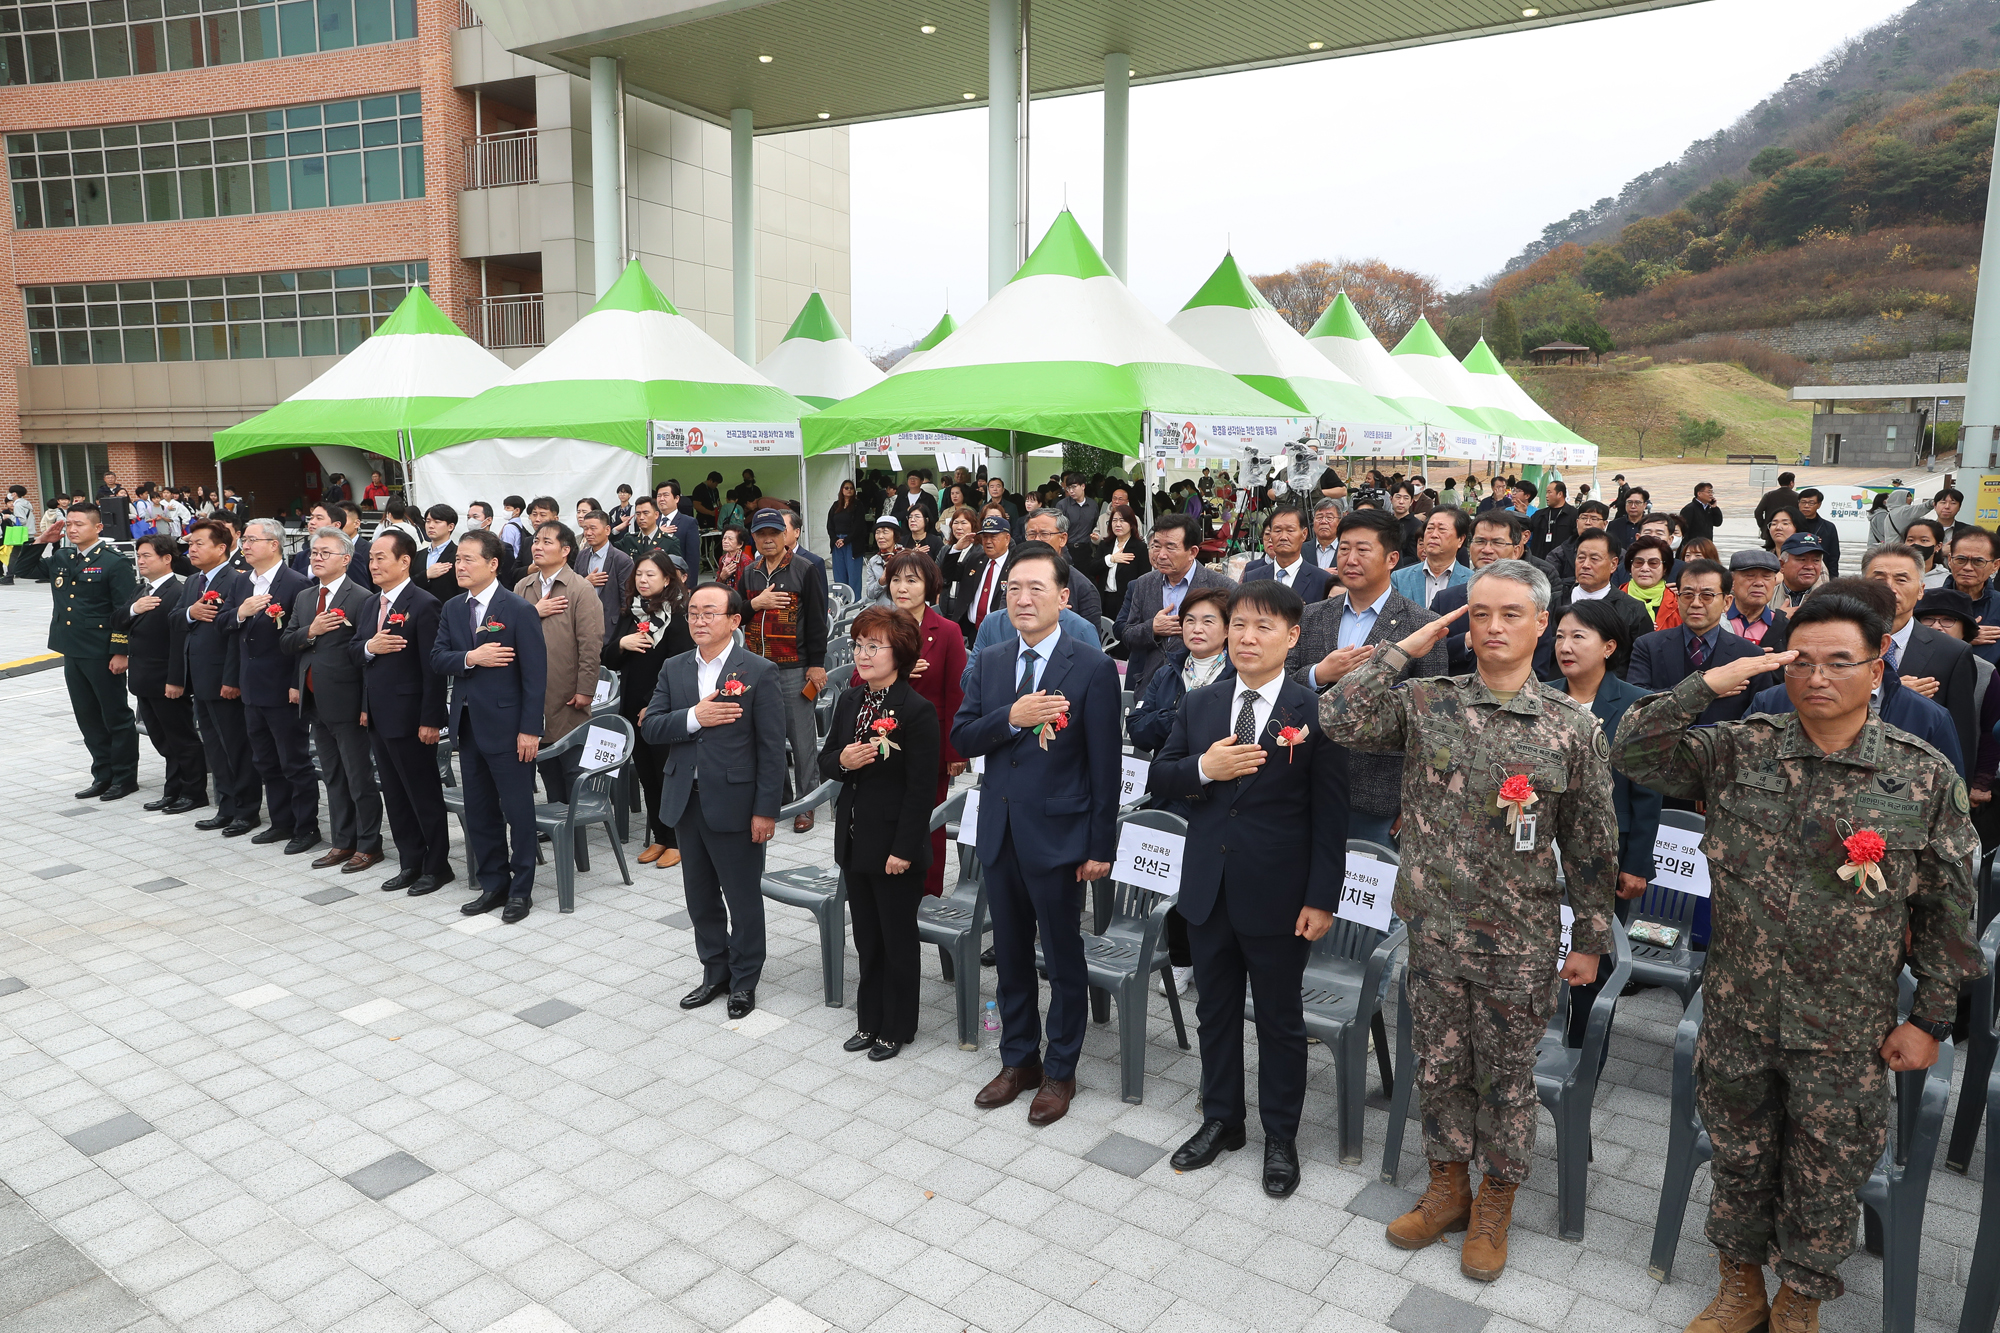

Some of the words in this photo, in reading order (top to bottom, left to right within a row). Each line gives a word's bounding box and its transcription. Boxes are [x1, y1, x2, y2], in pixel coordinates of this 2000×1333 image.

[726, 430, 757, 438] 전곡고등학교
[758, 430, 783, 438] 자동차학과
[785, 430, 795, 438] 체험
[1183, 427, 1196, 444] 26
[1212, 425, 1226, 436] 환경을
[1227, 425, 1245, 436] 생각하는
[1246, 425, 1255, 436] 착한
[690, 431, 703, 445] 22
[1339, 431, 1346, 445] 27
[1978, 509, 1998, 519] 가고
[595, 749, 615, 763] 김영호
[1901, 804, 1919, 812] ROKA
[1141, 842, 1171, 857] 연천교육장
[1655, 840, 1678, 851] 연천군
[1681, 846, 1697, 856] 의회
[1134, 855, 1171, 878] 안선근
